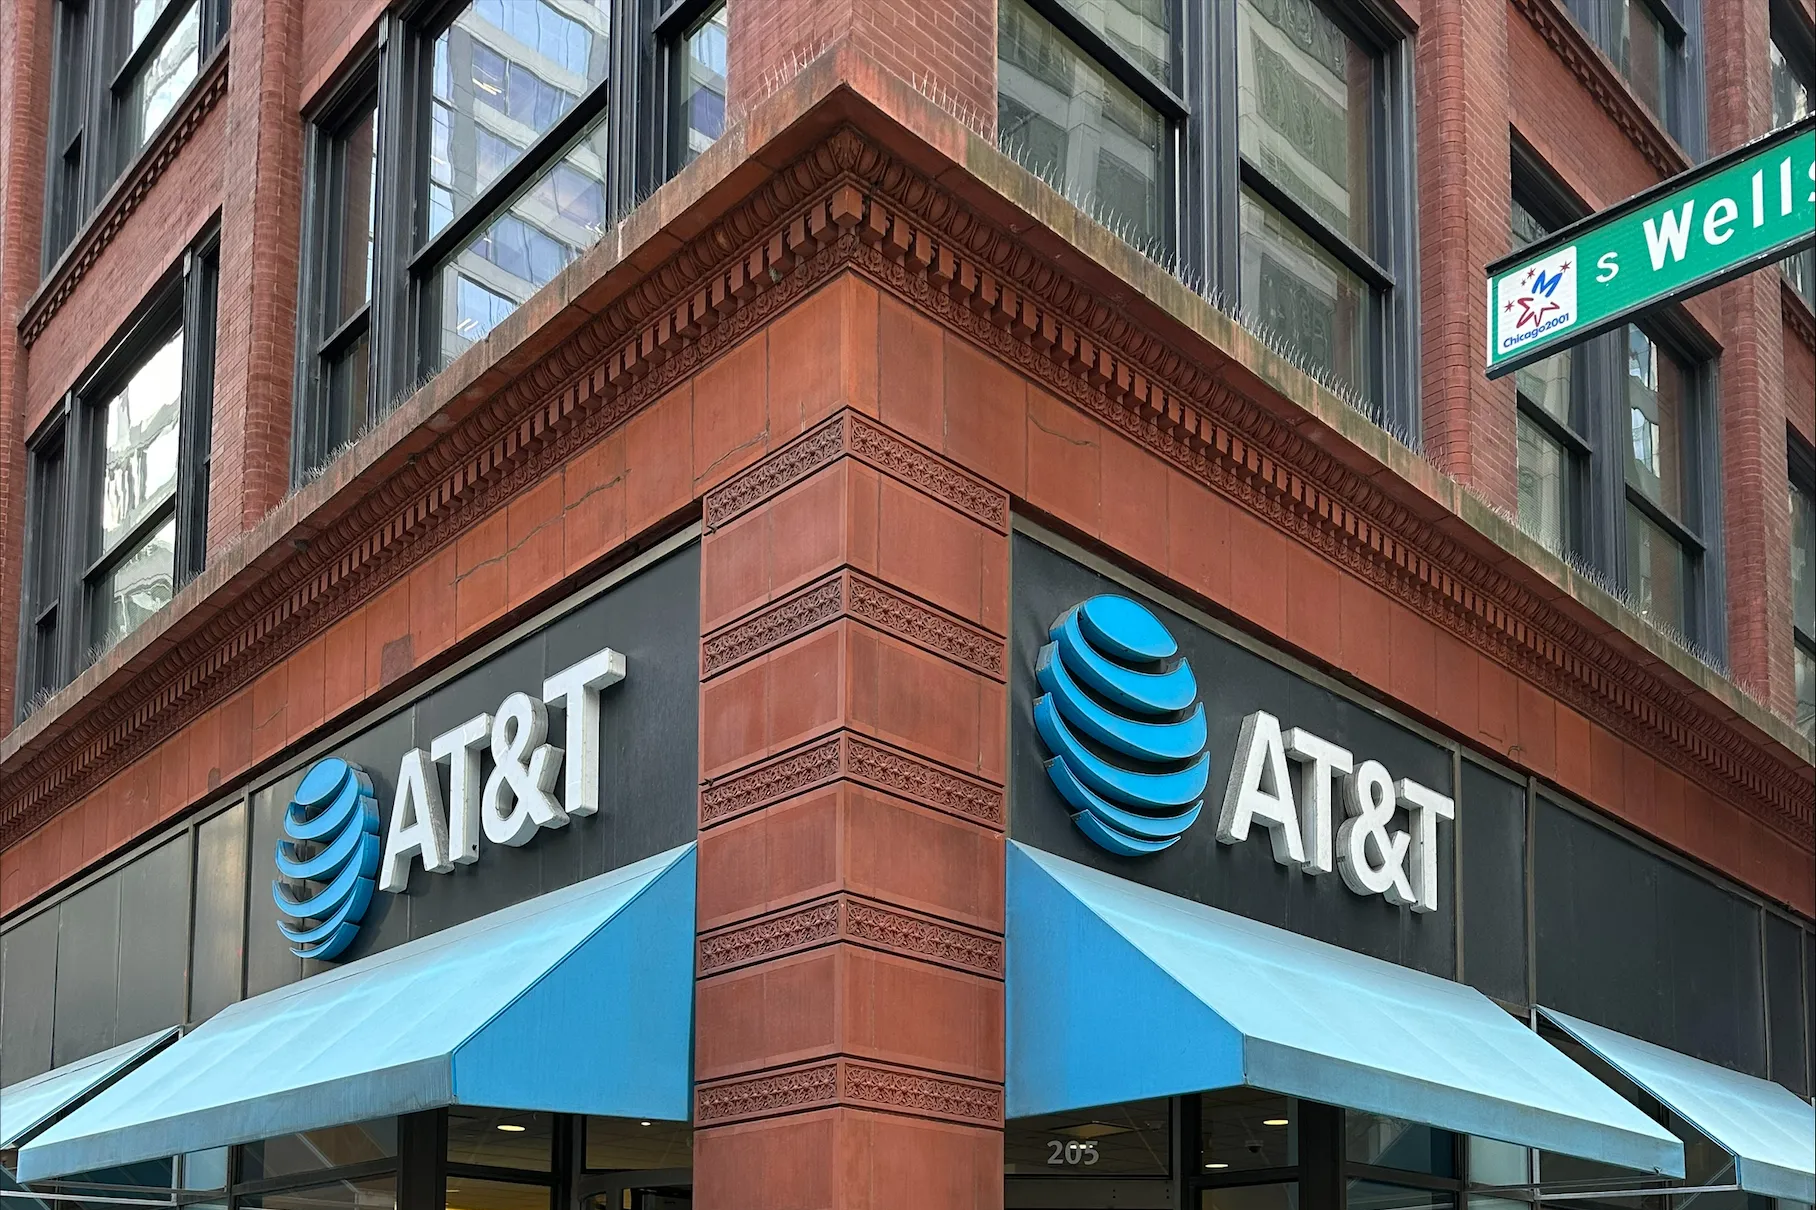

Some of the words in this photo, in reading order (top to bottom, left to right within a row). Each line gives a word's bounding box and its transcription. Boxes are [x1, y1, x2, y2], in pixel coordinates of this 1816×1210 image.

[1595, 251, 1620, 283] S
[1642, 156, 1816, 272] Well
[1503, 313, 1570, 349] Chicago2001
[379, 647, 627, 893] AT&T
[1216, 710, 1455, 913] AT&T
[1047, 1140, 1100, 1166] 205
